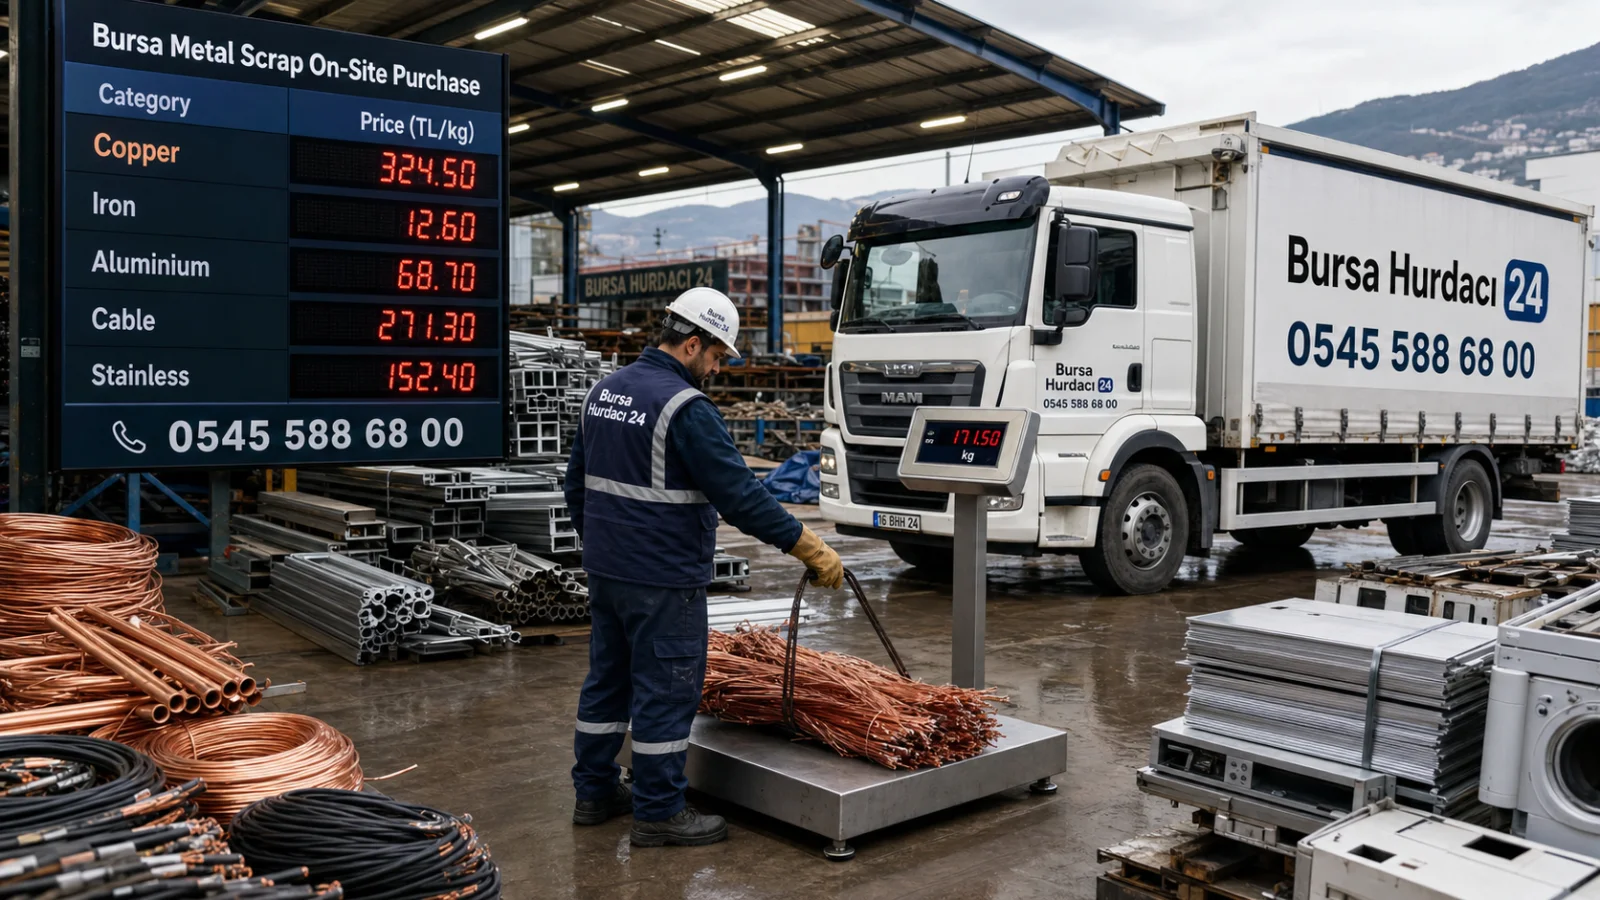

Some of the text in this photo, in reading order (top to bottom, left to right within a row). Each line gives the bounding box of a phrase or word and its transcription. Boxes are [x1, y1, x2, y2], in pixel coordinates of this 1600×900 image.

[92, 22, 481, 96] Bursa Metal Scrap On-Site Purchase
[99, 82, 191, 117] Category
[360, 111, 475, 146] Price (TL/kg)
[94, 132, 180, 167] Copper
[380, 151, 476, 190] 324.50
[92, 191, 136, 217] Iron
[408, 209, 476, 242] 12.60
[91, 249, 210, 278] Aluminium
[398, 259, 476, 292] 68.70
[1287, 234, 1543, 315] Bursa Hurdacı 24
[585, 266, 714, 297] BURSA HURDACI 24
[91, 306, 156, 332] Cable
[378, 309, 476, 343] 271.30
[1287, 320, 1535, 379] 0545 588 68 00
[91, 363, 190, 388] Stainless
[388, 361, 476, 392] 152.40
[1045, 378, 1112, 392] Hurdacı 24
[1056, 362, 1093, 377] Bursa
[599, 388, 634, 407] Bursa
[1043, 398, 1118, 409] 0545 588 68 00
[587, 402, 647, 427] Hurdacı 24
[169, 417, 464, 453] 0545 588 68 00
[953, 429, 1001, 447] 171.50
[961, 449, 975, 463] kg
[878, 514, 887, 526] 16
[907, 517, 918, 529] 24
